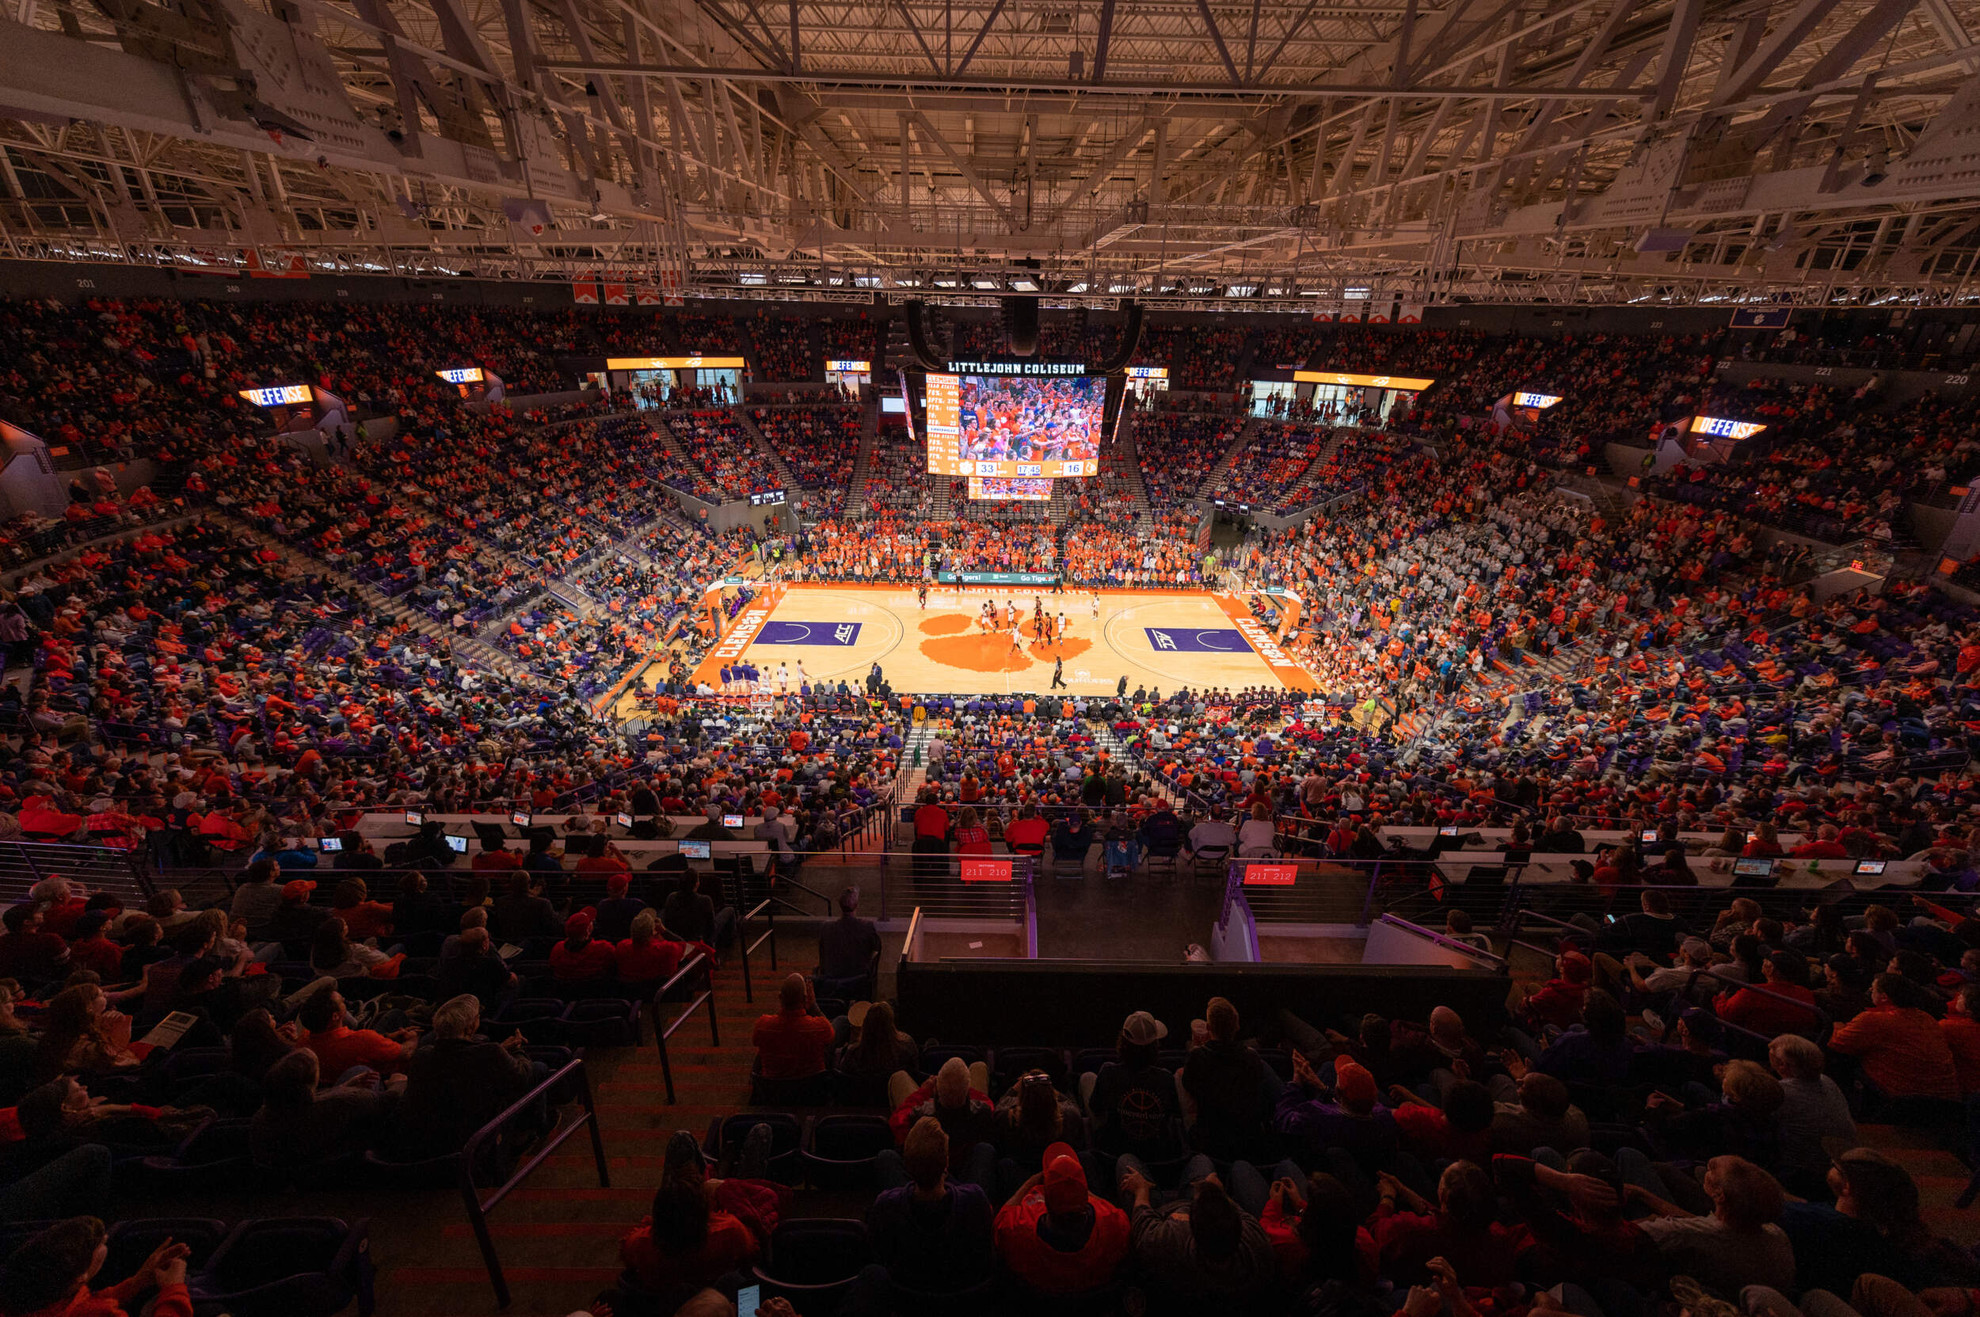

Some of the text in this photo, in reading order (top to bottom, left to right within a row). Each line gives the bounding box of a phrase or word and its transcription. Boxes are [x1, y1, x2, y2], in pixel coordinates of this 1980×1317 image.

[76, 278, 96, 288] 201
[832, 361, 865, 370] DEFENSE
[948, 362, 1085, 374] LITTLEJOHN COLISEUM
[1129, 367, 1163, 377] DEFENSE
[1815, 367, 1832, 376] 221
[441, 368, 479, 383] DEFENSE
[1945, 374, 1969, 384] 220
[249, 386, 304, 405] DEFENSE
[1519, 392, 1558, 408] DEFENSE
[1699, 417, 1759, 438] DEFENSE
[981, 464, 994, 473] 33
[1068, 464, 1080, 472] 16
[715, 610, 769, 658] CLEMSON
[834, 624, 852, 642] ACC
[1155, 630, 1177, 650] ACC
[1235, 618, 1296, 667] CLEMSON
